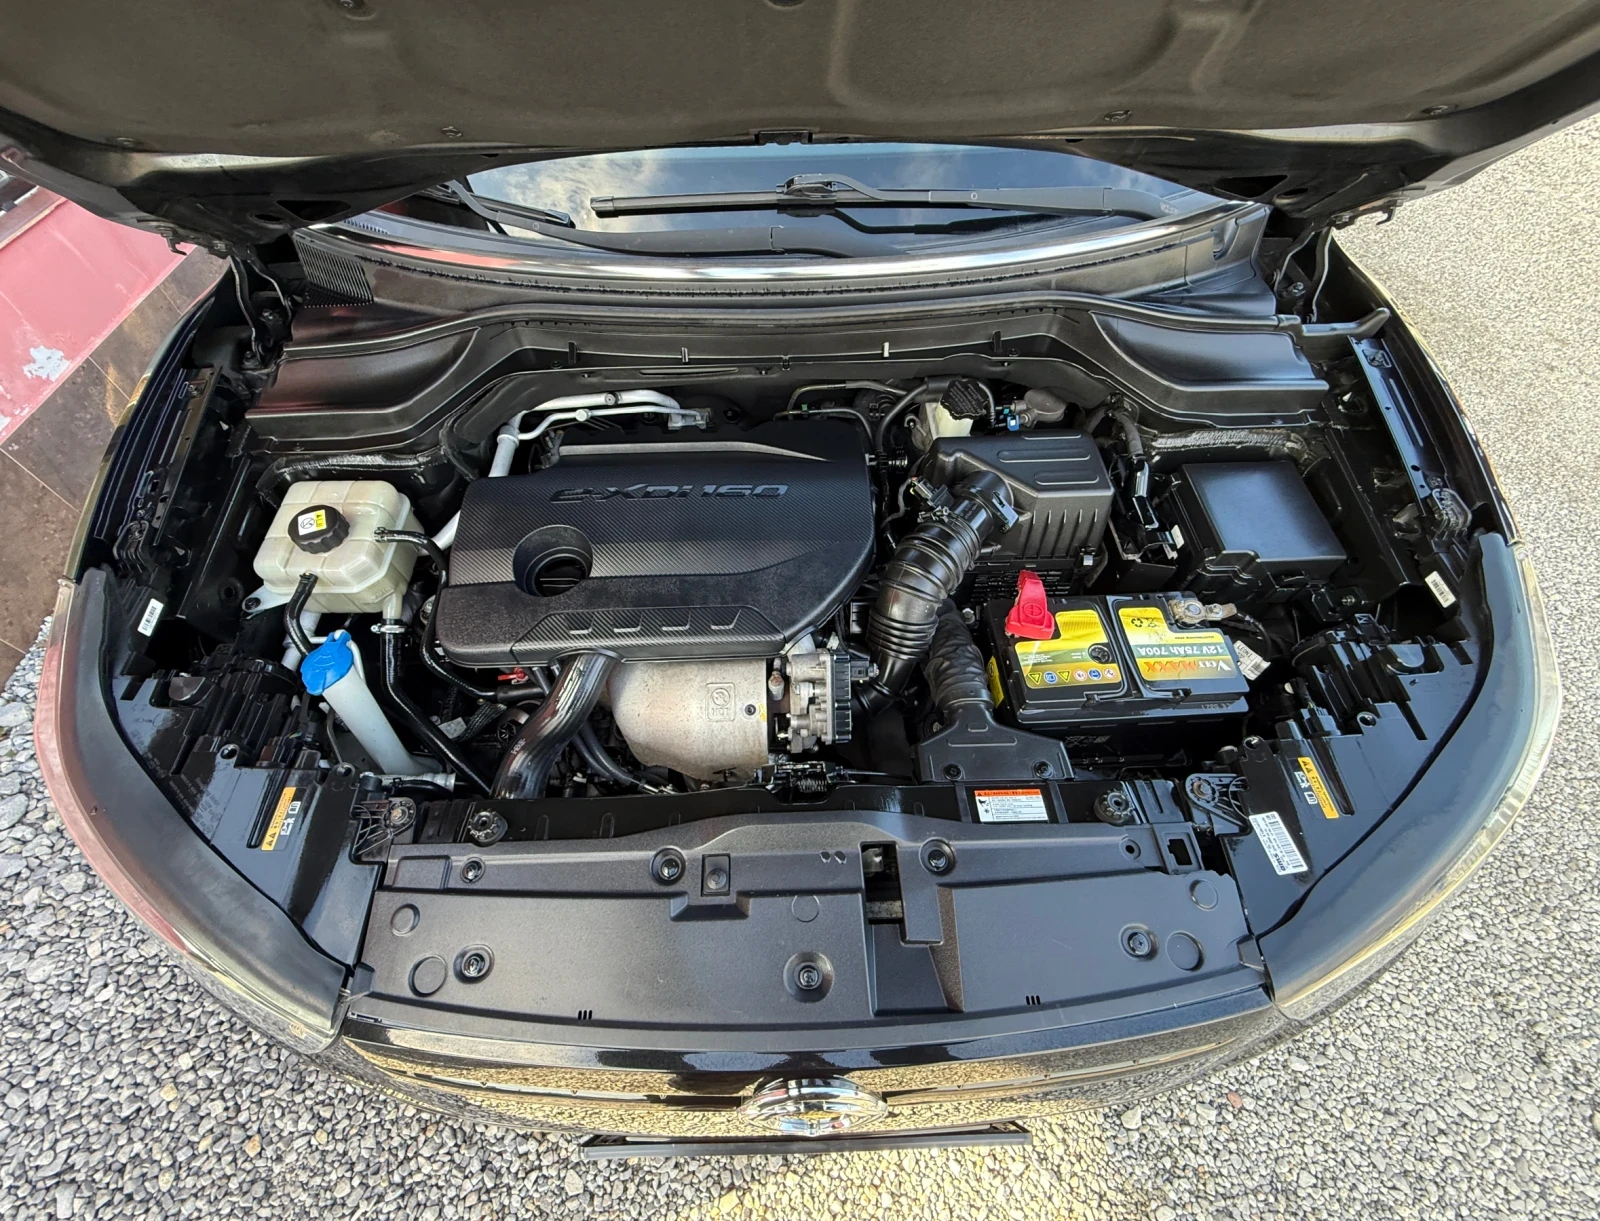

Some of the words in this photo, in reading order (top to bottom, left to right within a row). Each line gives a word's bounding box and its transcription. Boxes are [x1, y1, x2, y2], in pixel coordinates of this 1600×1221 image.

[1137, 646, 1168, 656] 700A
[1169, 646, 1200, 655] 75Ah
[1202, 645, 1224, 654] 12V
